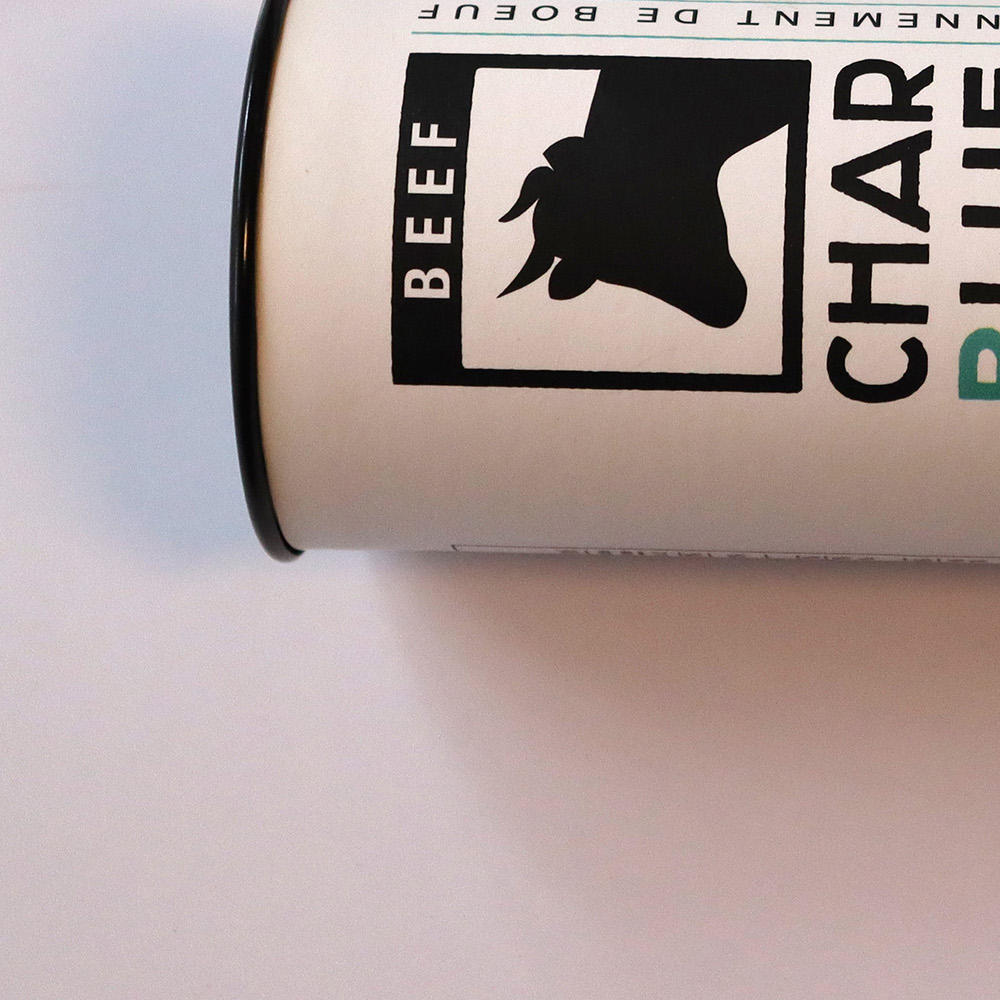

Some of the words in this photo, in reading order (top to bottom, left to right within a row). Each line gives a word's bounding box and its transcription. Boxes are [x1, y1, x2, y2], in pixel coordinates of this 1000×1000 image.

[417, 4, 598, 23] BOEUF
[636, 7, 699, 25] DE
[403, 122, 458, 299] BEEF
[826, 58, 935, 404] CHAR
